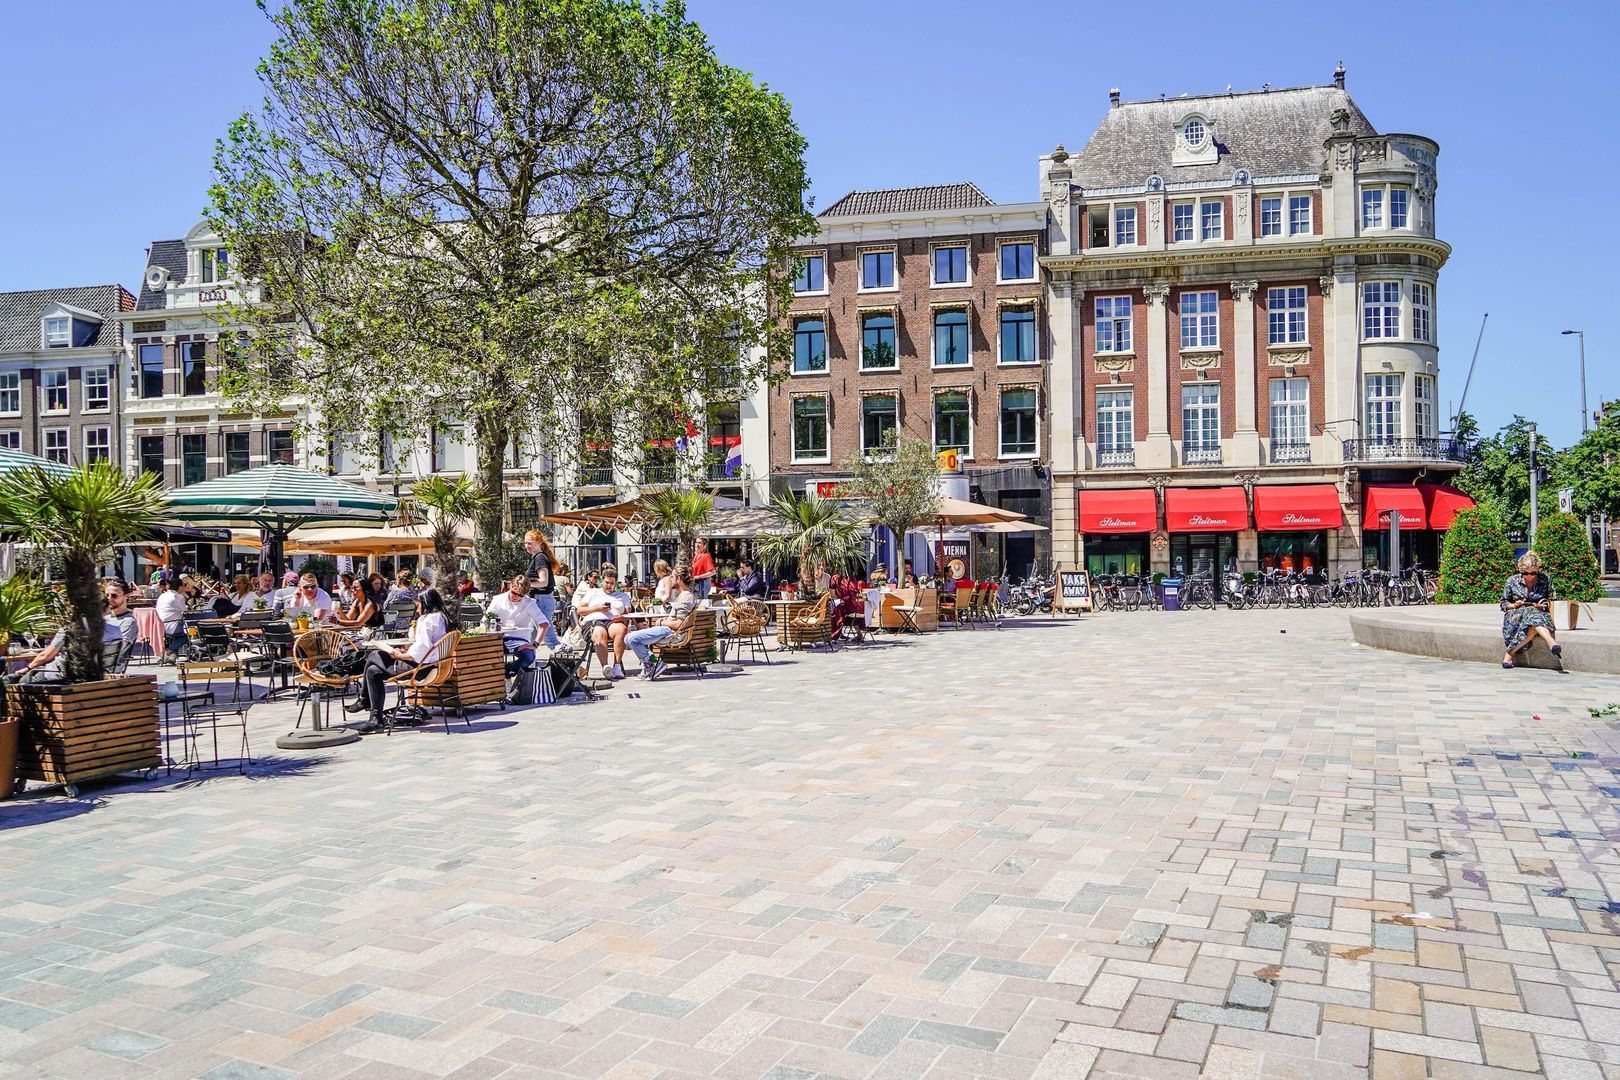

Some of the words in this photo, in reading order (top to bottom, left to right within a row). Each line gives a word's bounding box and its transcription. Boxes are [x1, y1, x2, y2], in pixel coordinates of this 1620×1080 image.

[1099, 517, 1137, 526] Steltman
[1189, 515, 1227, 524] Steltman
[1282, 514, 1320, 523] Steltman
[943, 546, 967, 556] VIENNA
[1061, 574, 1087, 586] TAKE
[1063, 586, 1087, 597] AWAY
